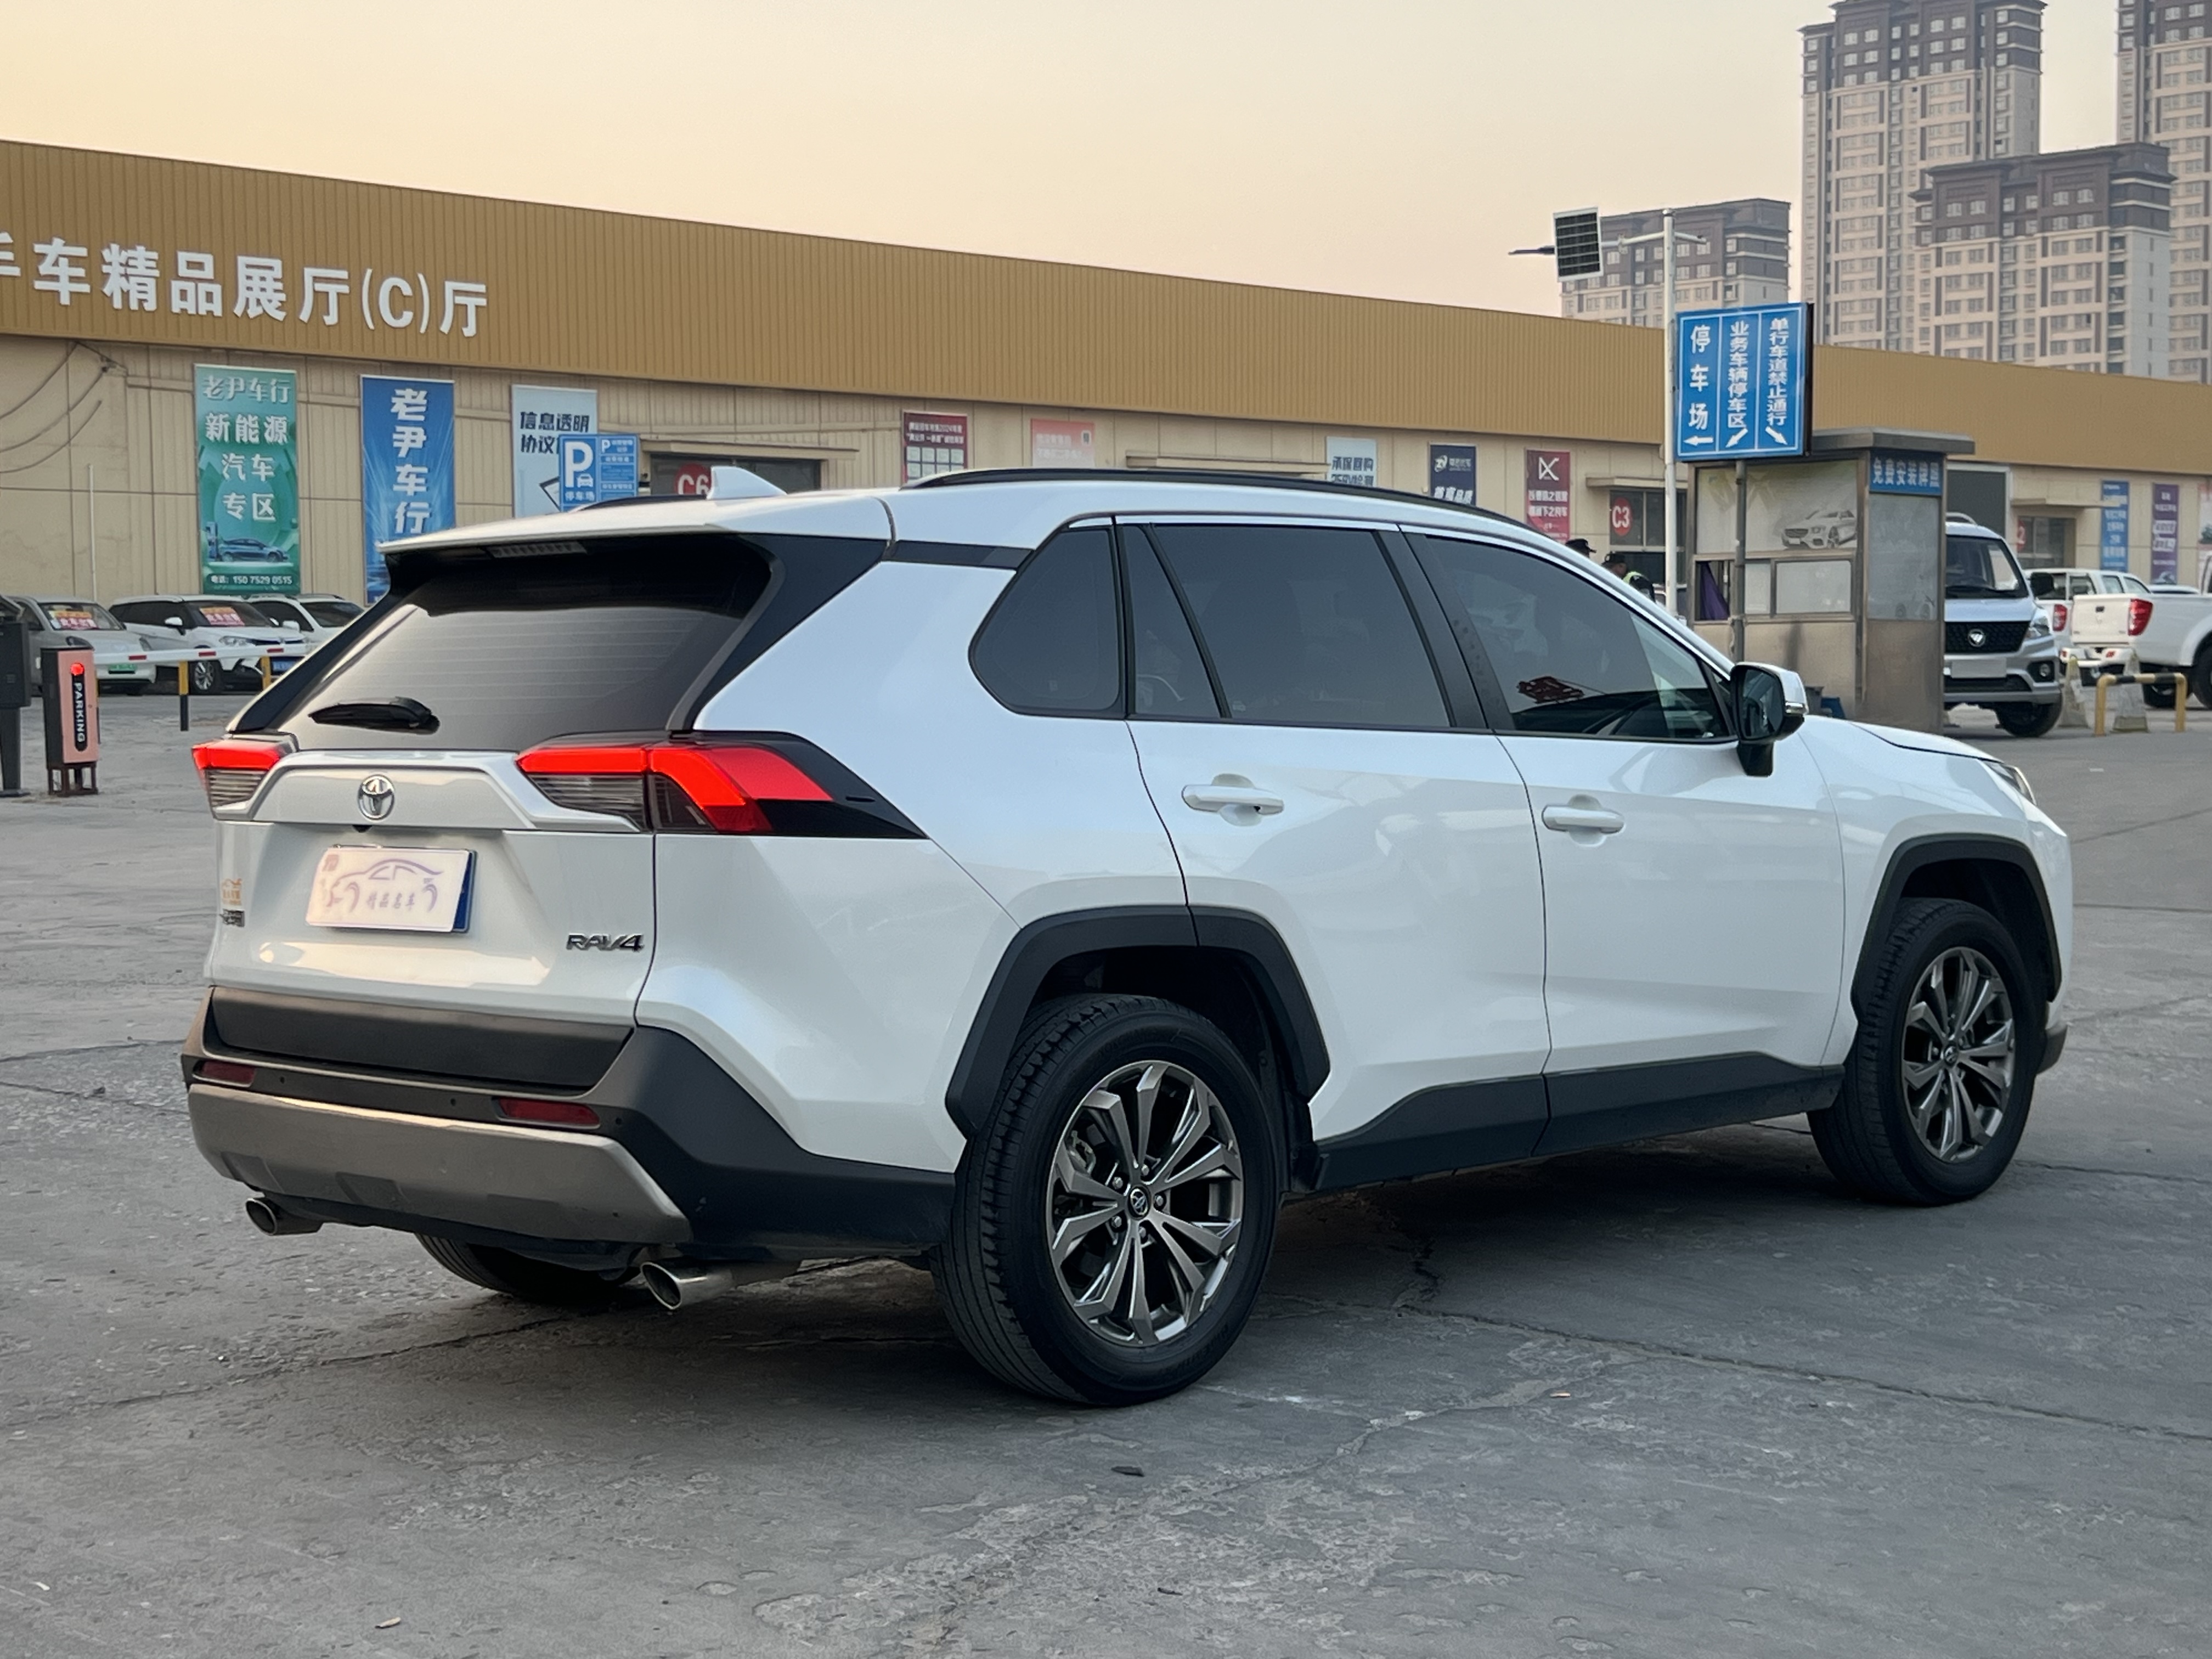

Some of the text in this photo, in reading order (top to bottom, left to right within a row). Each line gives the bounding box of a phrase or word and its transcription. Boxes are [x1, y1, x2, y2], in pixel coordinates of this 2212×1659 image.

[1689, 324, 1711, 430] 停车场
[1728, 320, 1750, 428] 业务车辆停车区
[1767, 317, 1790, 426] 单行车道禁止通行
[203, 375, 291, 403] 老尹车行
[205, 413, 289, 444] 新能源
[520, 411, 590, 433] 信息透明
[521, 434, 559, 455] 协议
[221, 453, 275, 482] 汽车
[390, 388, 432, 534] 老尹车行
[565, 441, 594, 488] P
[678, 474, 711, 495] C6
[222, 492, 276, 522] 专区
[1612, 506, 1630, 528] C3
[233, 576, 248, 584] 150
[250, 576, 270, 584] 7529
[272, 576, 292, 584] 0515
[74, 682, 85, 742] PARKING
[566, 933, 644, 952] RAV4
